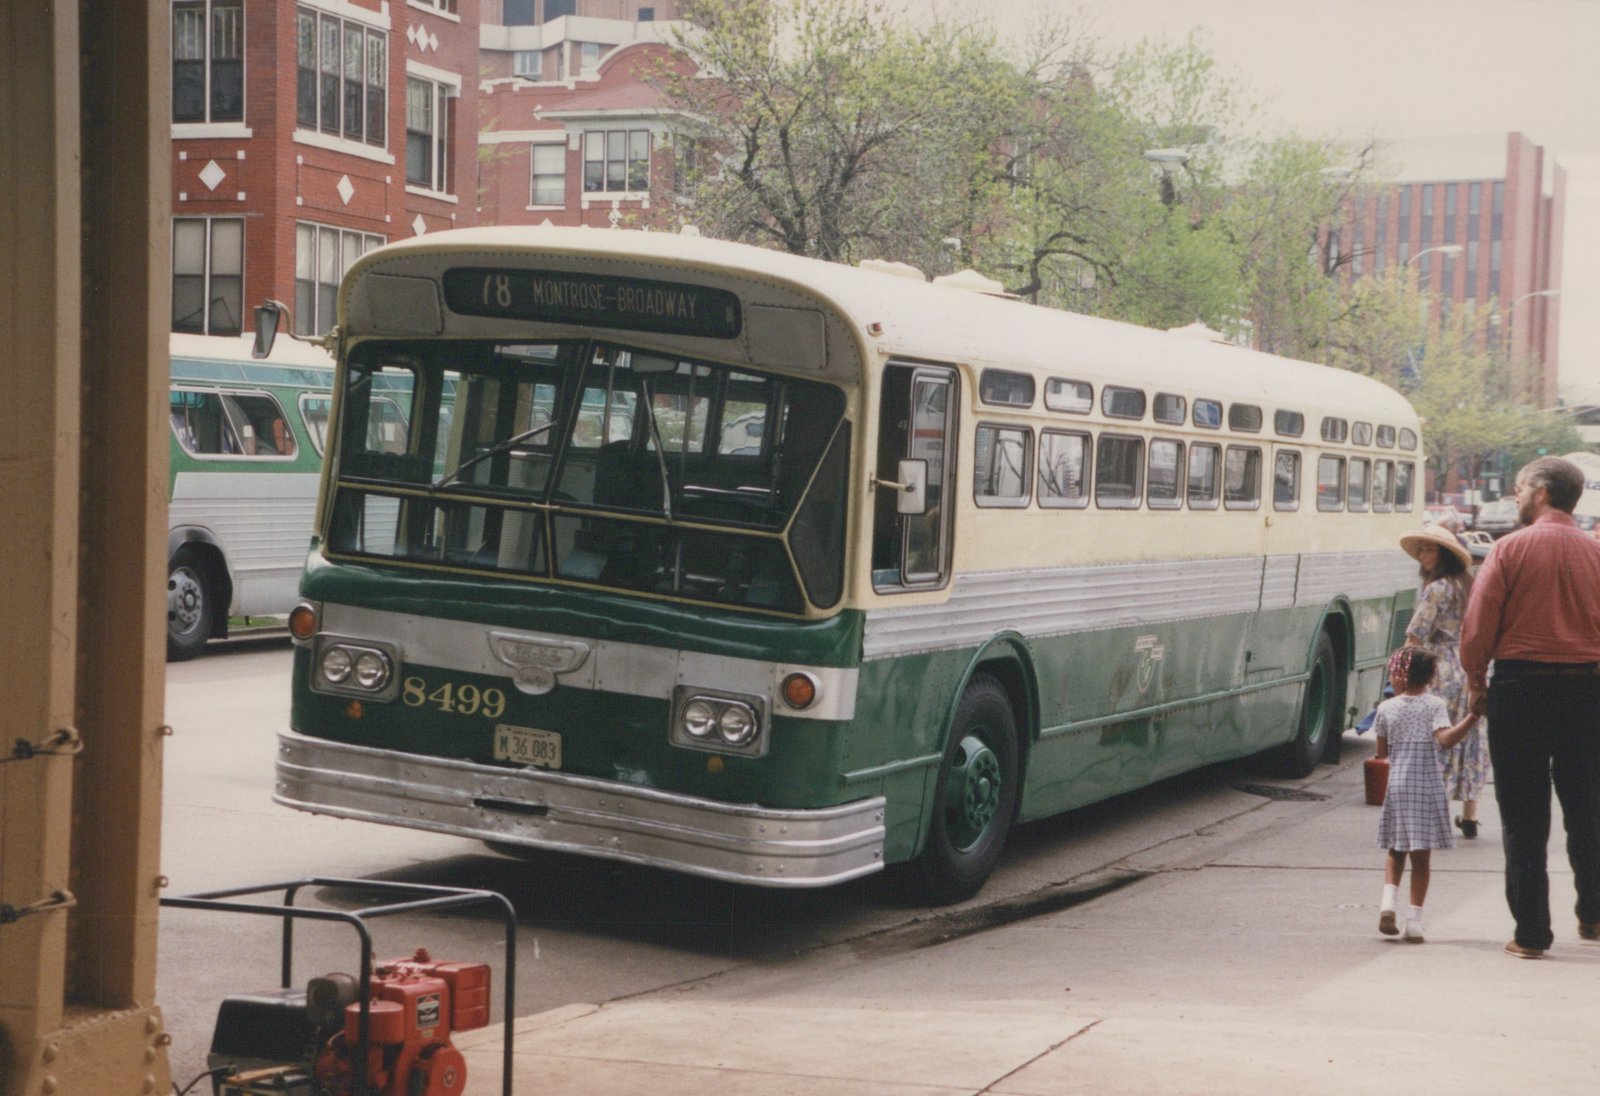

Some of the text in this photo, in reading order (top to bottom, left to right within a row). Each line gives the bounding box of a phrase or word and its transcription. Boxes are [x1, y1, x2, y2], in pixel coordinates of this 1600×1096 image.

[483, 274, 512, 308] 78
[532, 278, 697, 319] MONTROSE-BROADWAY
[402, 676, 506, 718] 8499
[512, 736, 528, 756] 36
[532, 739, 556, 760] 083
